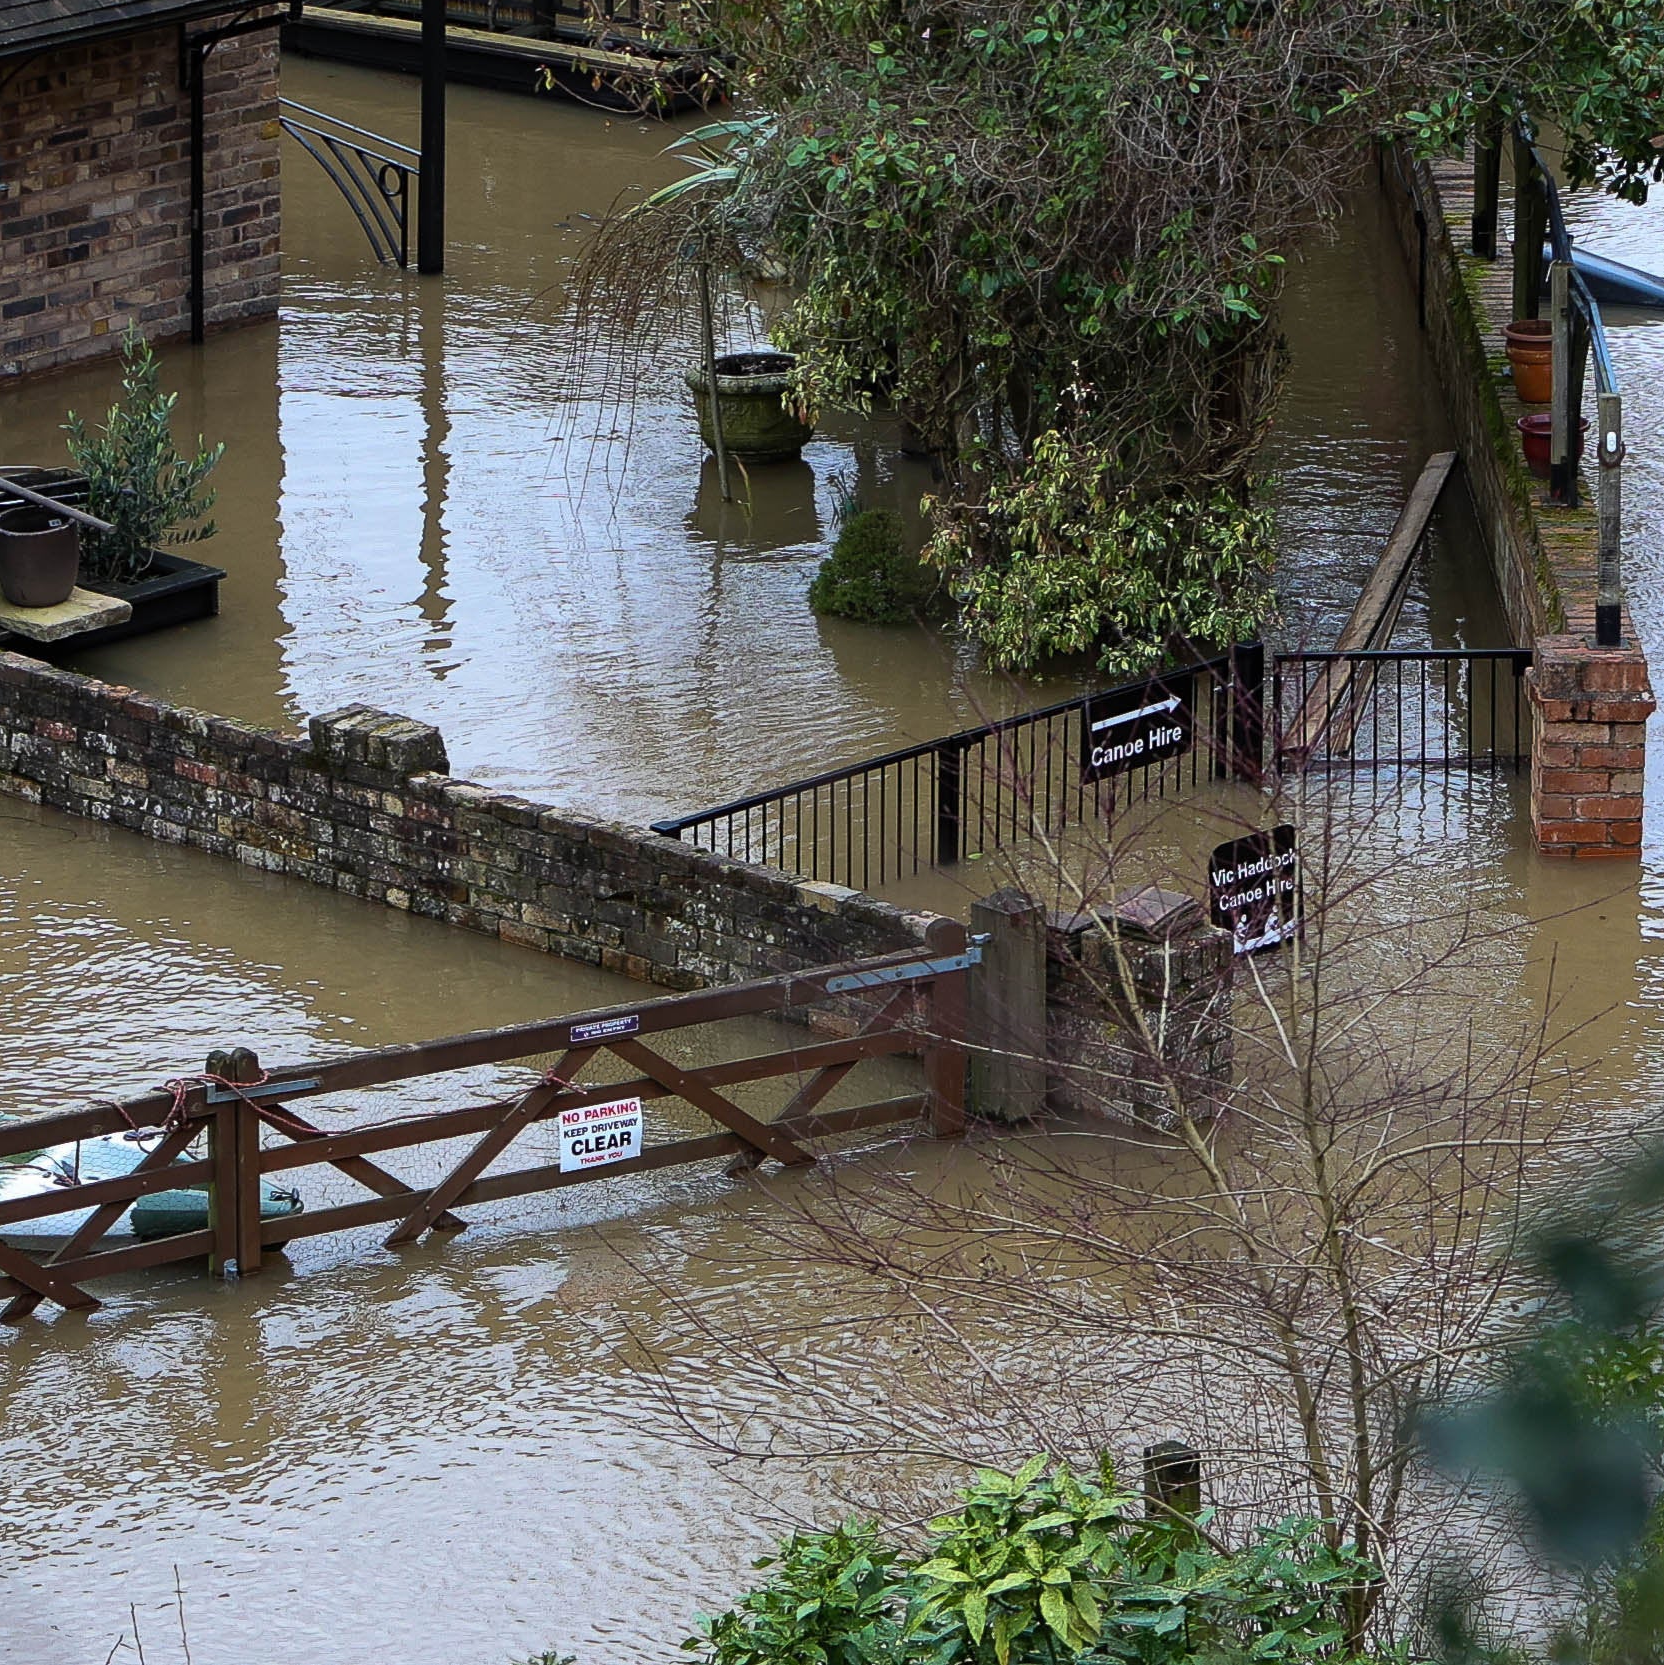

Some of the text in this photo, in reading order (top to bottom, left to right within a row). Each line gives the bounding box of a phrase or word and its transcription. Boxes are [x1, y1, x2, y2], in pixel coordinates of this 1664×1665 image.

[1091, 726, 1182, 766] Canoe Hire
[1212, 868, 1234, 886] Vic
[1219, 878, 1294, 910] Canoe Hre
[562, 1101, 638, 1124] NO PARKING
[564, 1118, 638, 1139] KEEP DRIVEWAY
[571, 1131, 632, 1156] CLEAR
[580, 1151, 623, 1165] THANK YOU
